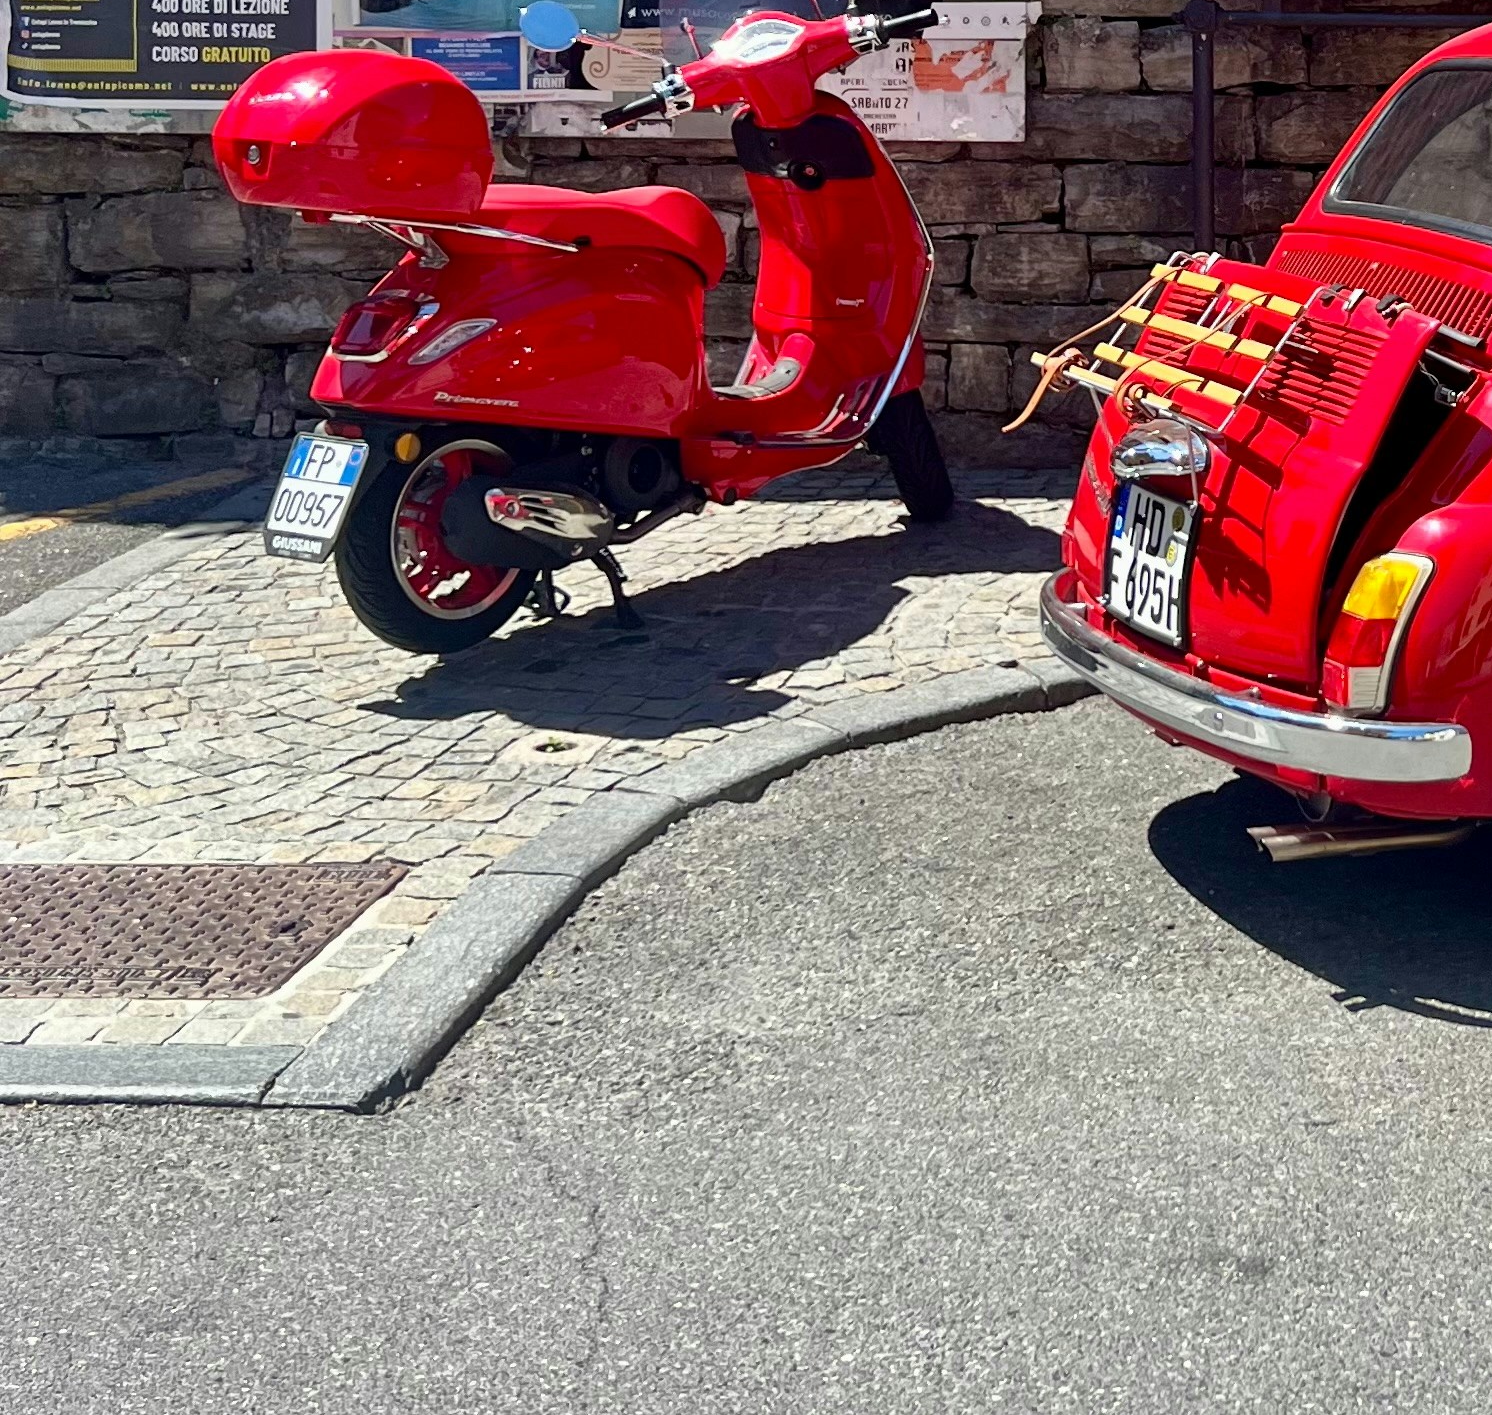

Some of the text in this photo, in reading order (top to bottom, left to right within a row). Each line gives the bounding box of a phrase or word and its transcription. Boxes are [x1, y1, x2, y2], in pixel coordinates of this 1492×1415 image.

[232, 0, 289, 15] LEZIONE
[151, 22, 276, 39] 400 ORE DI STAGE
[152, 46, 271, 63] CORSO GRATUITO
[895, 97, 909, 109] 27
[303, 444, 336, 479] FP
[274, 488, 345, 530] 00957
[1130, 493, 1166, 557] HD
[272, 535, 322, 554] GIUSSANI
